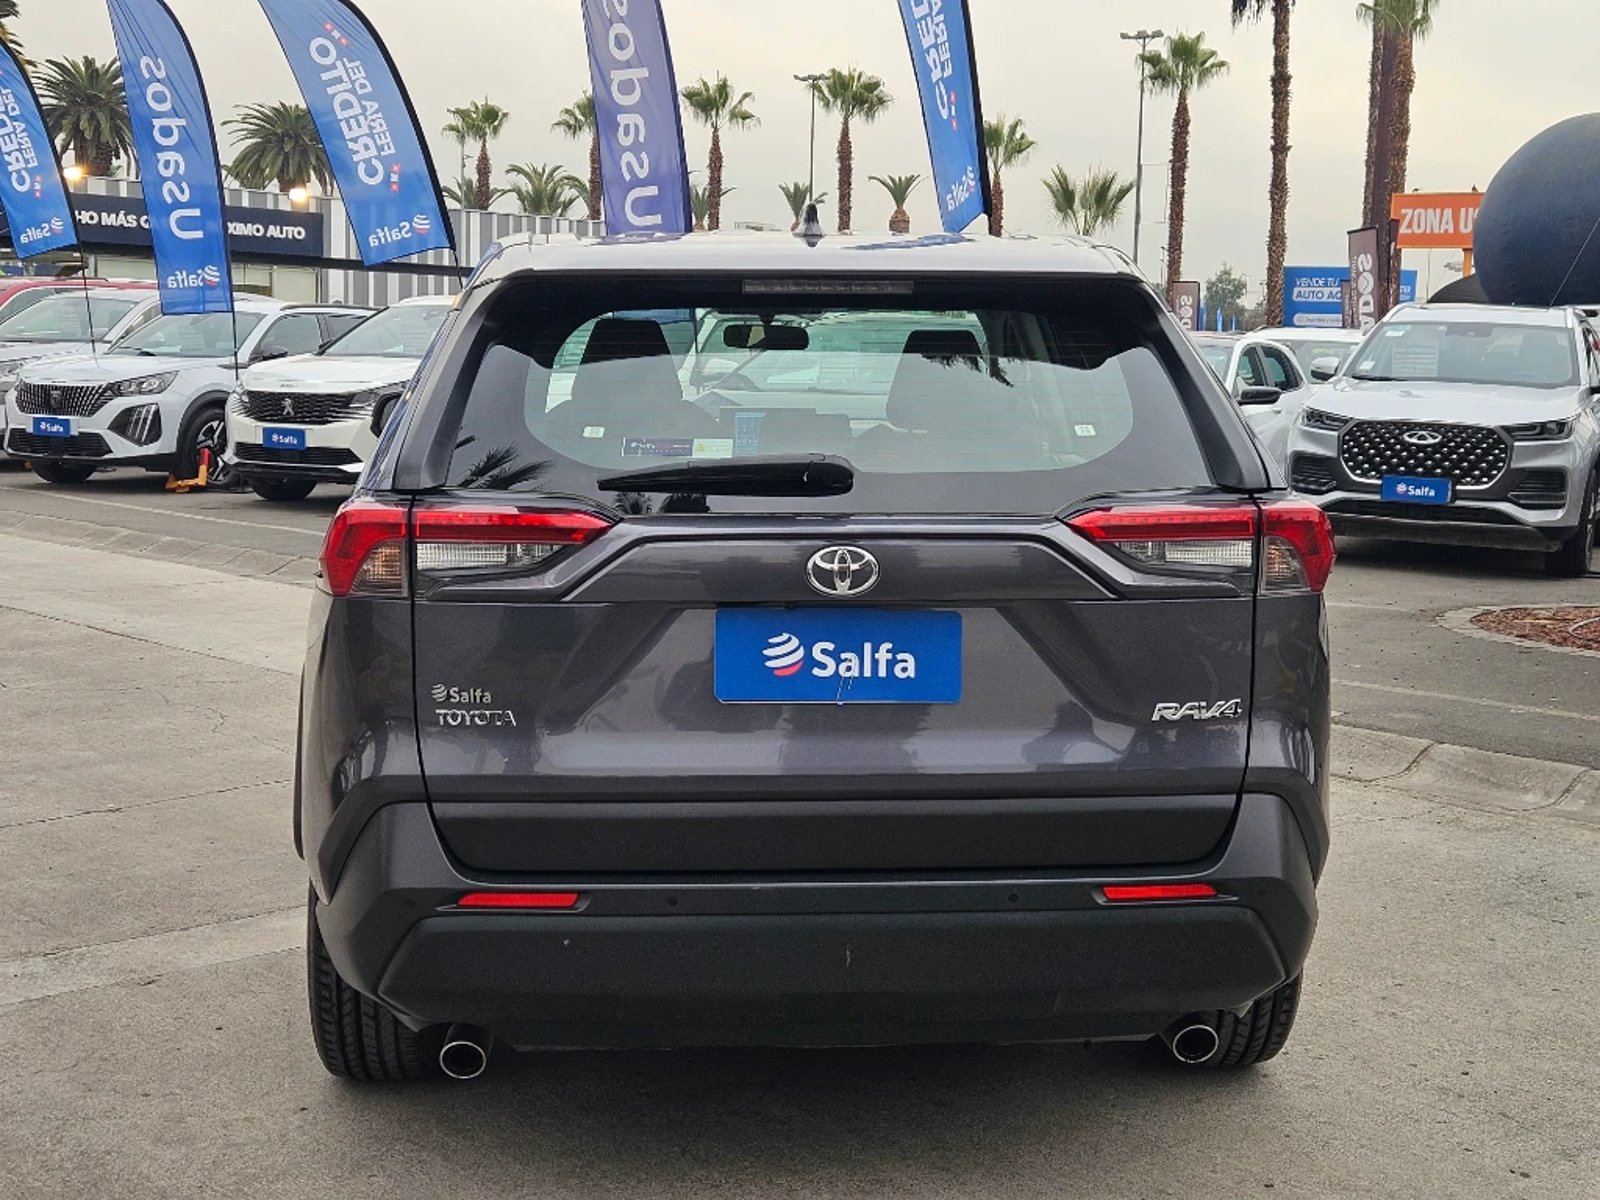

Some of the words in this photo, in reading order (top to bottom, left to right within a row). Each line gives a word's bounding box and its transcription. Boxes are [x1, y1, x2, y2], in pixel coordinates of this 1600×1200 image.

[101, 210, 138, 228] MÁS
[266, 224, 306, 240] AUTO
[1400, 207, 1455, 234] ZONA
[1459, 207, 1481, 234] U
[1296, 277, 1325, 287] VENDE
[1327, 277, 1340, 287] TU
[1295, 290, 1324, 299] AUTO
[279, 435, 297, 445] Salfa
[1407, 485, 1435, 497] Salfa
[811, 641, 916, 679] Salfa
[449, 686, 492, 703] Salfa
[435, 708, 517, 727] TOYOTA
[1151, 698, 1242, 721] RAV4
